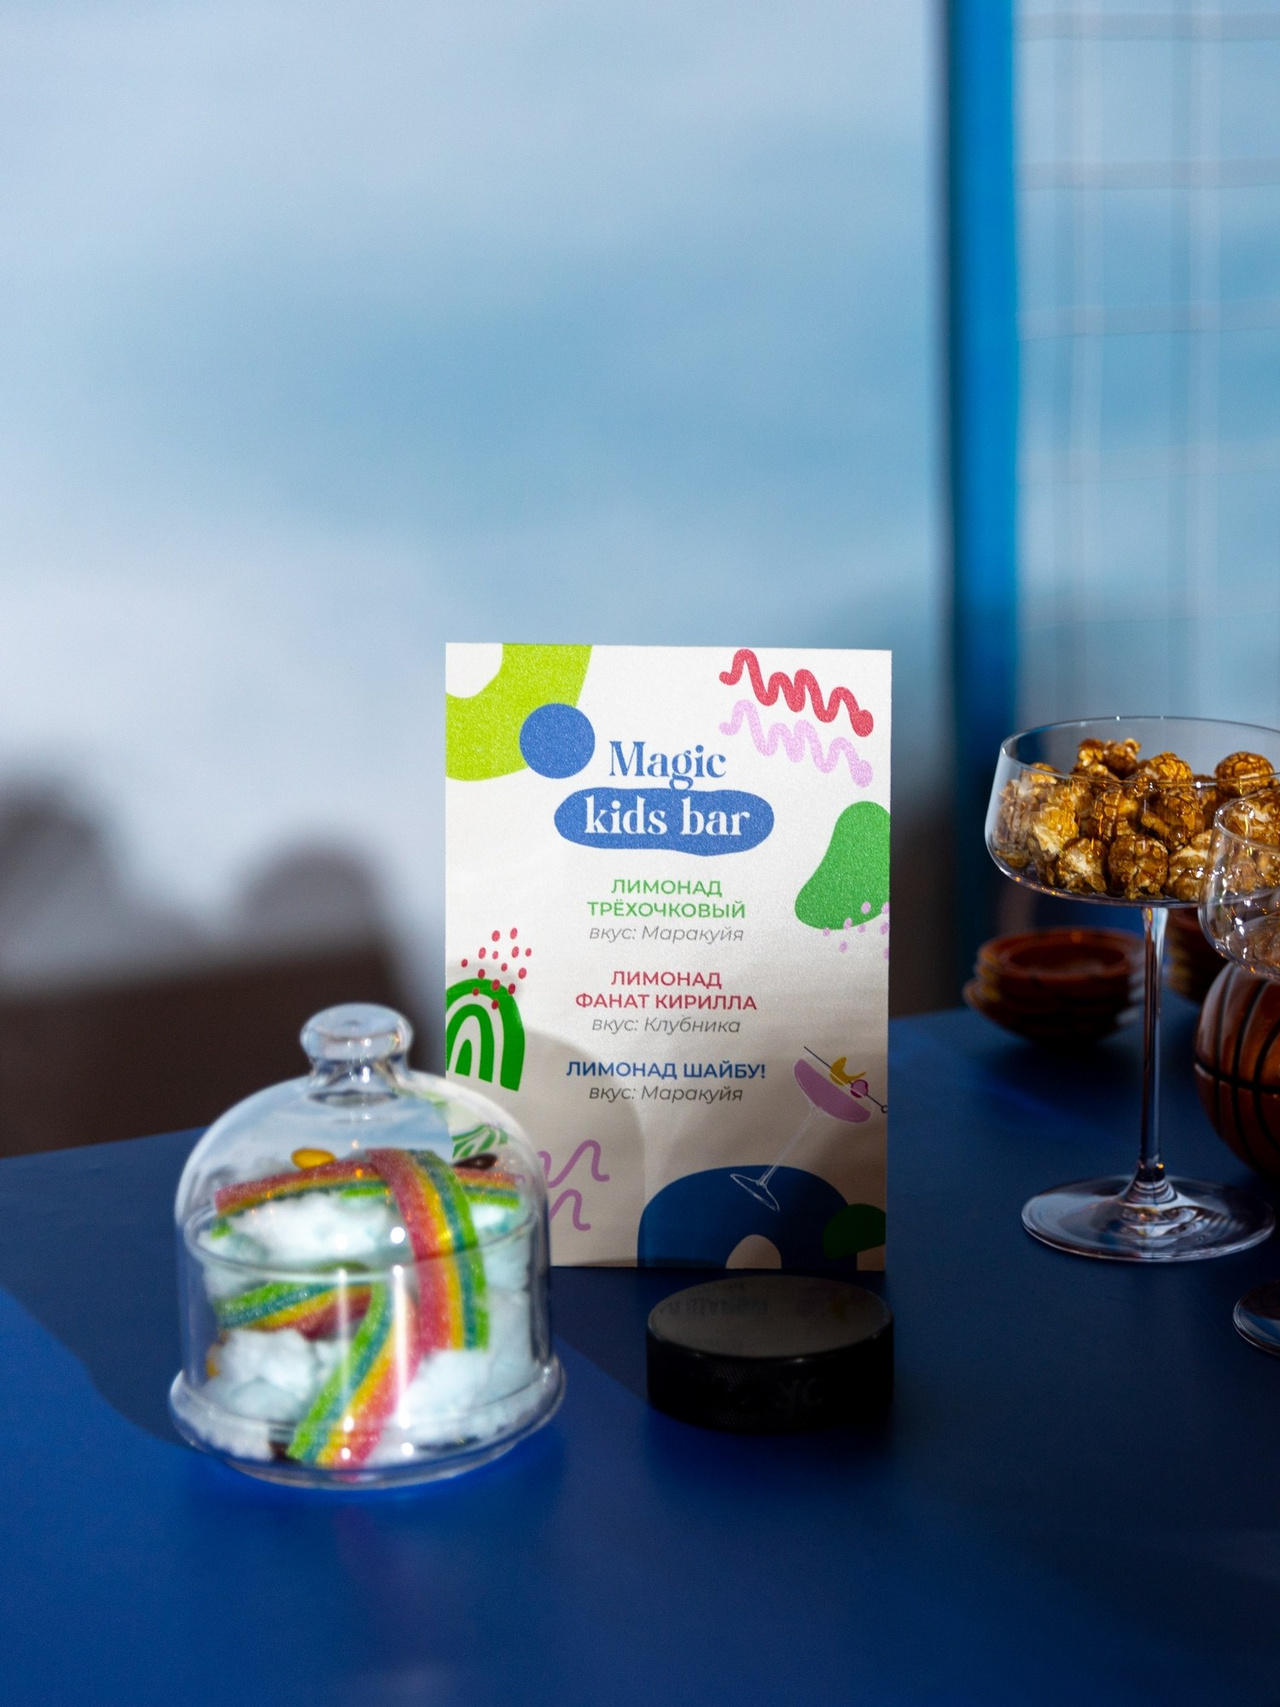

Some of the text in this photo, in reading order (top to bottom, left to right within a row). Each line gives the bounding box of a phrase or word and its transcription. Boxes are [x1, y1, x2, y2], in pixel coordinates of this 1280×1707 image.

[609, 741, 727, 790] Magic
[584, 795, 750, 836] kids bar
[611, 879, 722, 897] ЛИМОНАД
[587, 899, 746, 918] ТРЁХОЧКОВЫЙ
[589, 925, 744, 944] вкус: Маракуйя
[611, 971, 722, 989] ЛИМОНАД
[575, 993, 757, 1010] ФАНАТ КИРИЛЛА
[592, 1016, 741, 1035] вкус: Клубника
[566, 1060, 766, 1080] ЛИМОНАД ШАЙБУ!
[589, 1085, 743, 1104] вкус: Маракуйя
